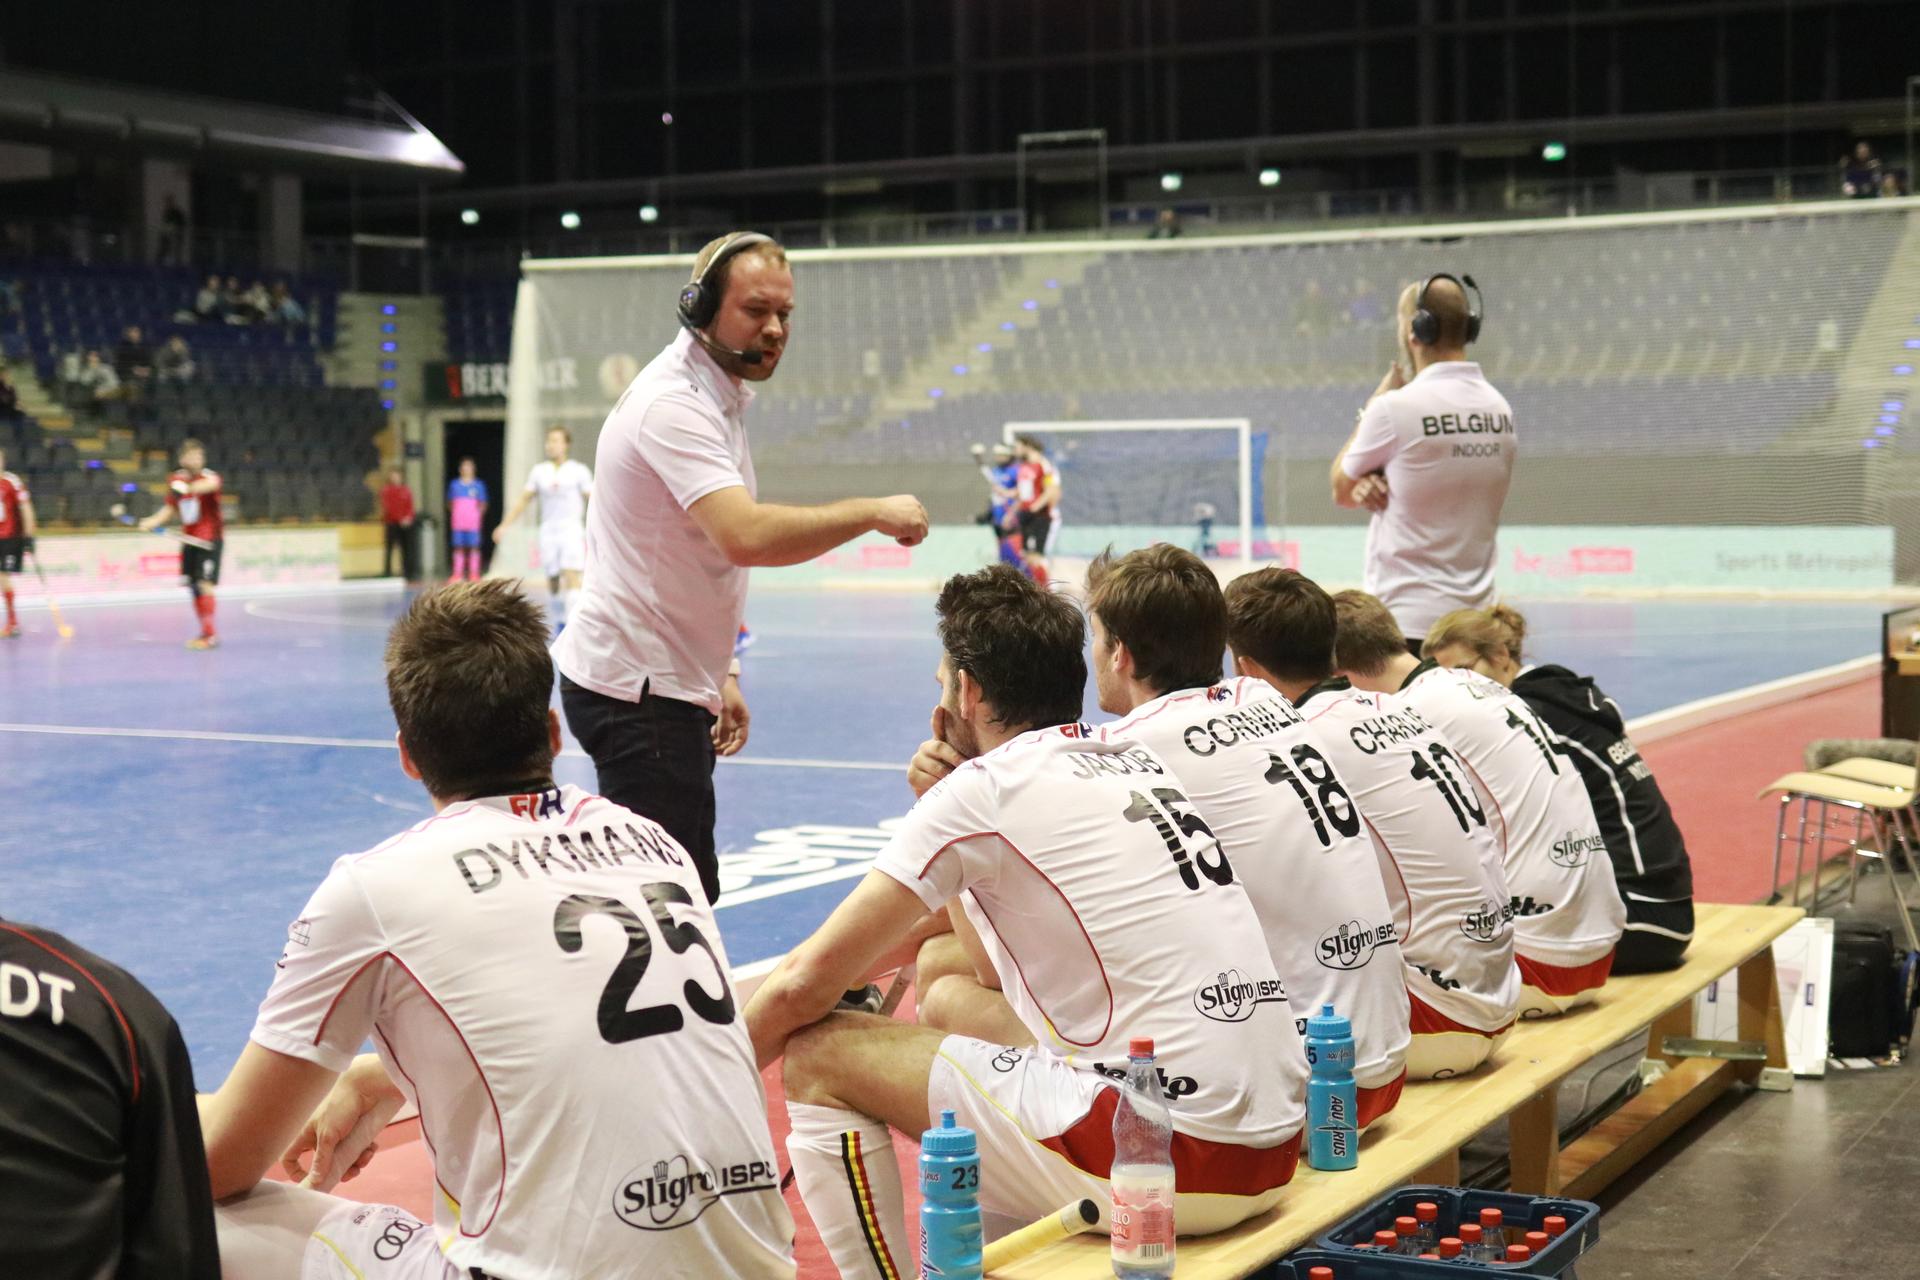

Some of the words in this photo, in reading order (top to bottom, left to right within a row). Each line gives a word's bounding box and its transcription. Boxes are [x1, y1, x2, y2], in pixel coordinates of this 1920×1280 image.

[1452, 442, 1500, 457] INDOOR
[508, 786, 565, 822] FIH
[1264, 743, 1360, 848] 18
[1411, 742, 1487, 834] 10
[452, 822, 684, 894] DYKMANS
[1123, 787, 1235, 891] 15
[1553, 830, 1592, 860] Sligro
[553, 881, 736, 1045] 25
[1321, 929, 1373, 960] Sligro
[1199, 979, 1255, 1012] Sligro
[1316, 1095, 1356, 1158] AQUARIUS
[623, 1171, 714, 1215] Sligro
[951, 1164, 979, 1191] 23
